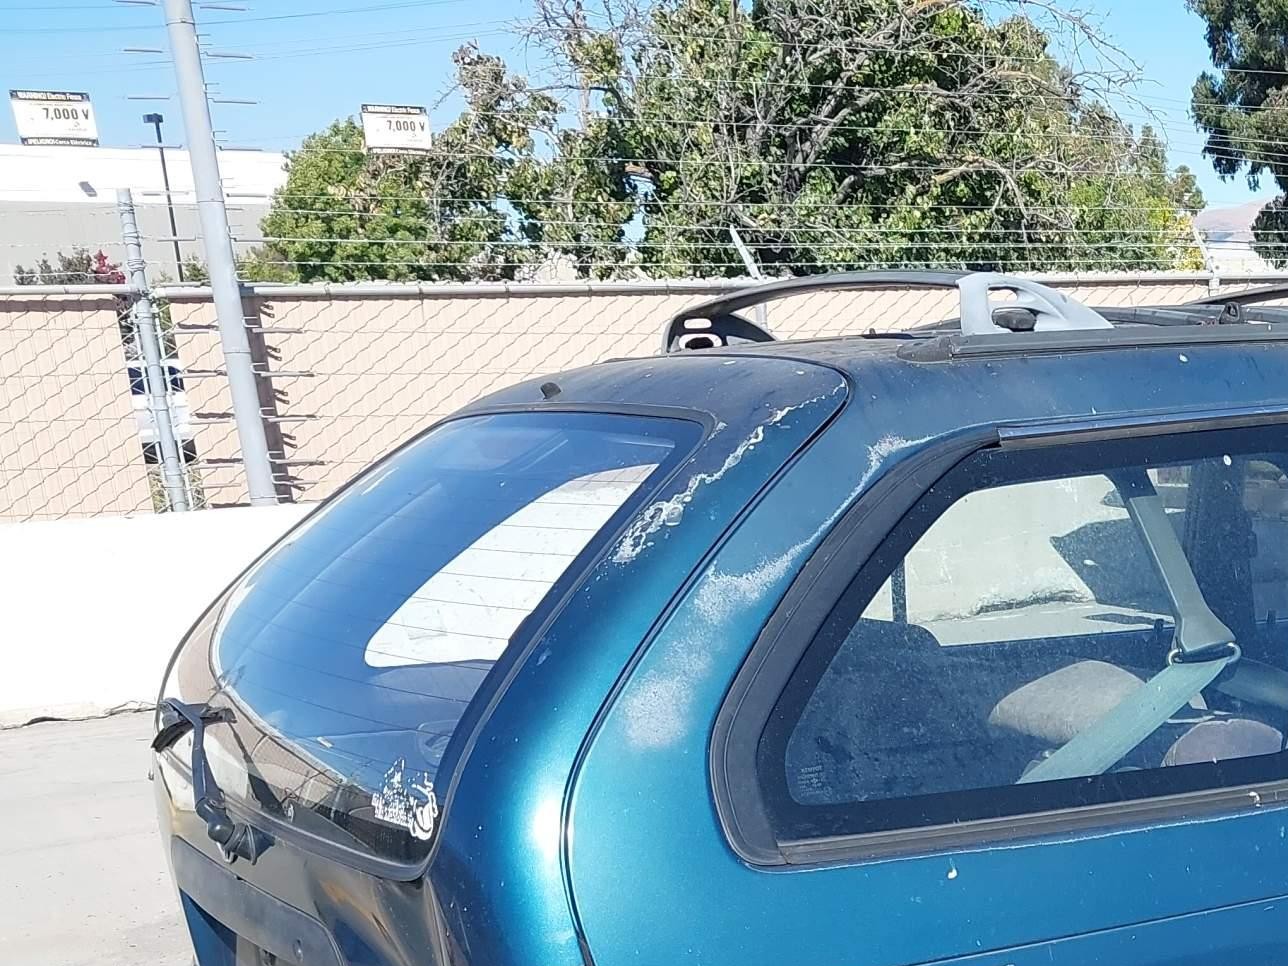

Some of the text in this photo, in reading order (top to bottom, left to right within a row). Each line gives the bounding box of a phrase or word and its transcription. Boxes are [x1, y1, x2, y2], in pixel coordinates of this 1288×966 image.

[42, 108, 89, 120] 7,000 V
[387, 120, 425, 132] 7,000 V
